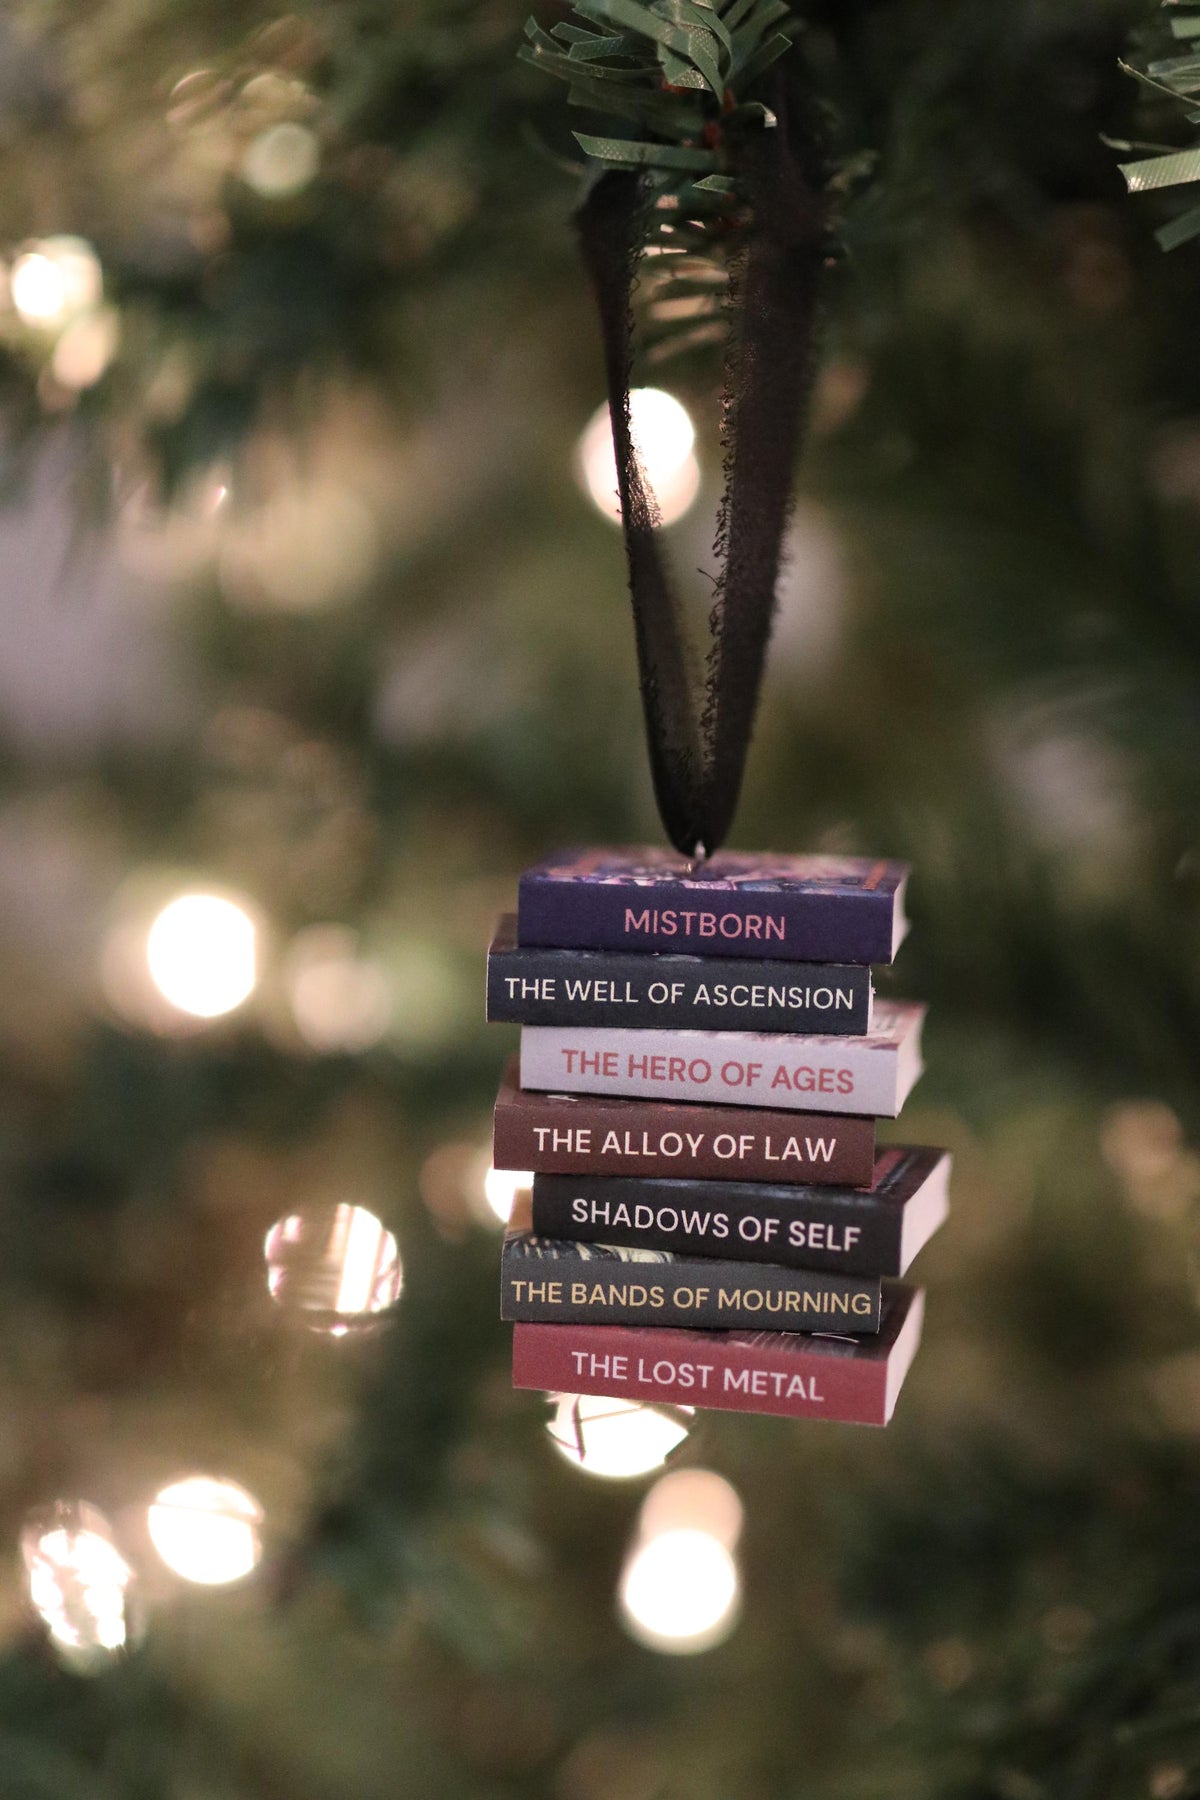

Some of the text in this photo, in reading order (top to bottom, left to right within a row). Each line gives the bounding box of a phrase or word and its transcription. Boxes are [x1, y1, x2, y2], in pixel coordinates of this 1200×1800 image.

[624, 907, 786, 941] MISTBORN
[504, 976, 854, 1011] THE WELL OF ASCENSION
[561, 1048, 855, 1095] THE HERO OF AGES
[532, 1127, 837, 1163] THE ALLOY OF LAW
[571, 1198, 861, 1253] SHADOWS OF SELF
[510, 1280, 873, 1316] THE BANDS OF MOURNING
[571, 1351, 825, 1402] THE LOST METAL
